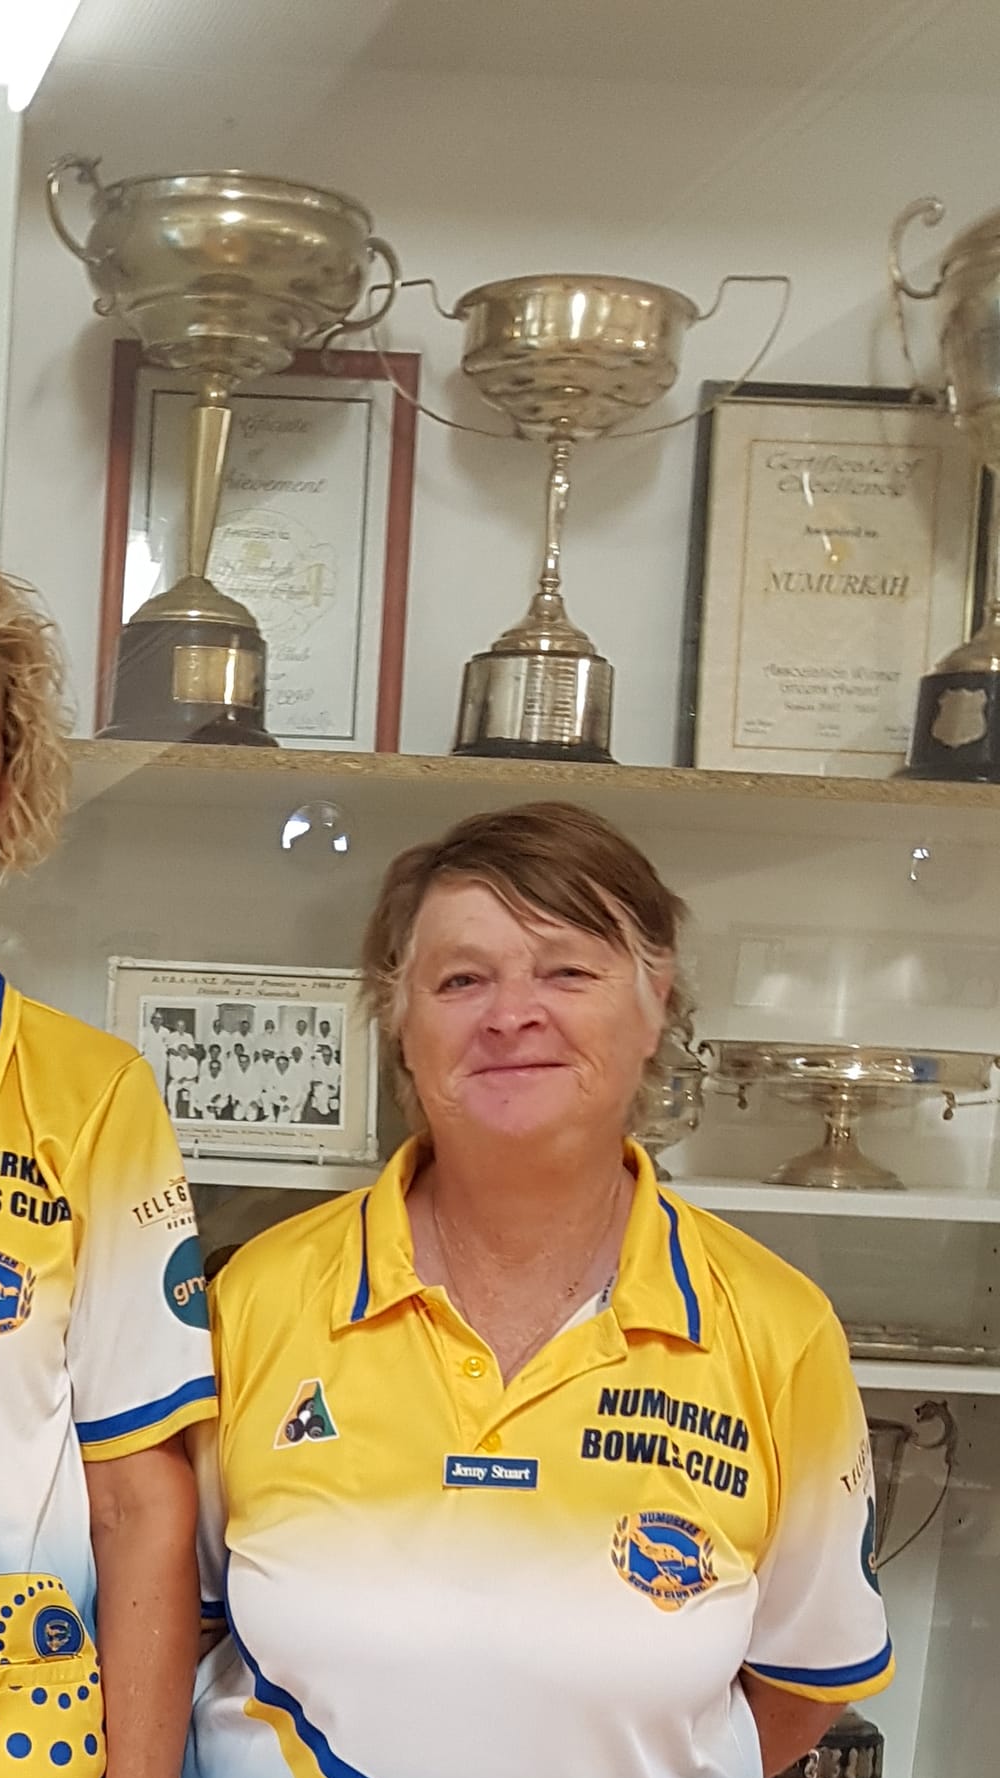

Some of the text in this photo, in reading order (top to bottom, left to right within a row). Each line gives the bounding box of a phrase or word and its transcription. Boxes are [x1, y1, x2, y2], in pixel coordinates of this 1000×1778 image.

[764, 571, 910, 598] NUMURKAH
[597, 1387, 750, 1453] NUMURKAH
[451, 1462, 531, 1481] Jenny Stuart
[686, 1449, 750, 1499] CLUB
